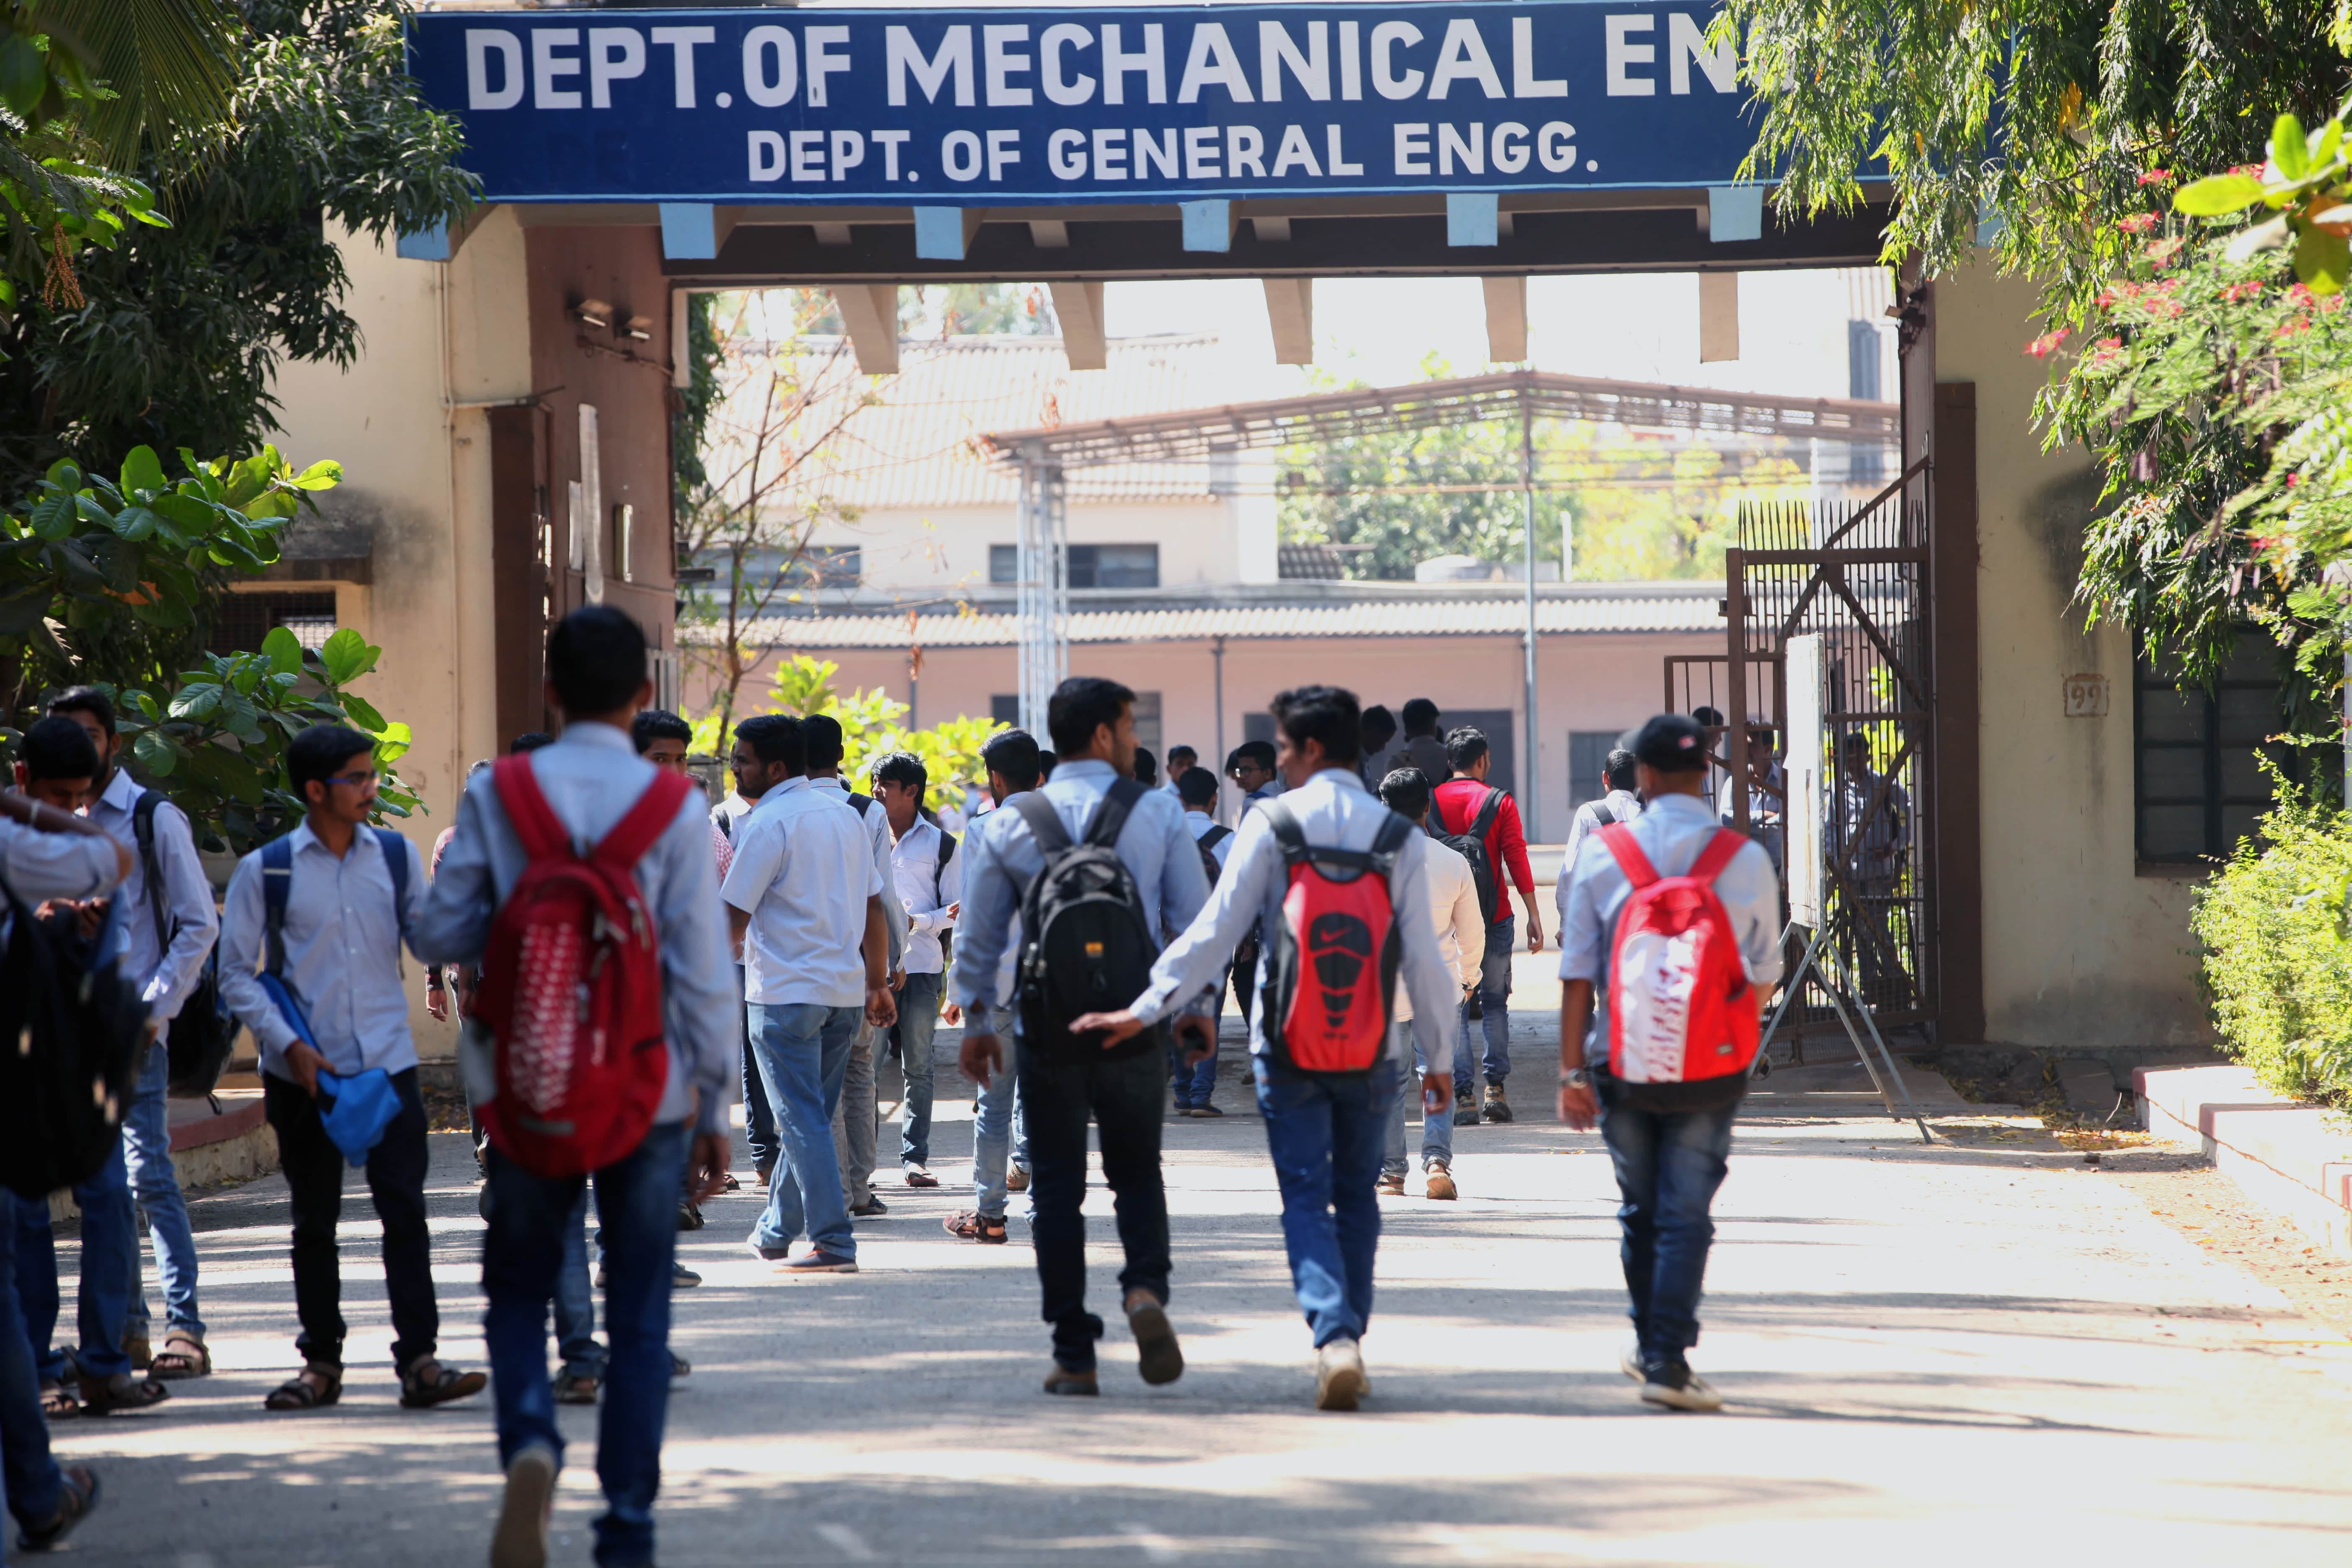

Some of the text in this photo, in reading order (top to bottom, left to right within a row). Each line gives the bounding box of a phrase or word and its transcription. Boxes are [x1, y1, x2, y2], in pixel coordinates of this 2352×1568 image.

[886, 17, 1568, 106] MECHANICAL
[748, 121, 1598, 181] DEPT. OF GENERAL ENGG.
